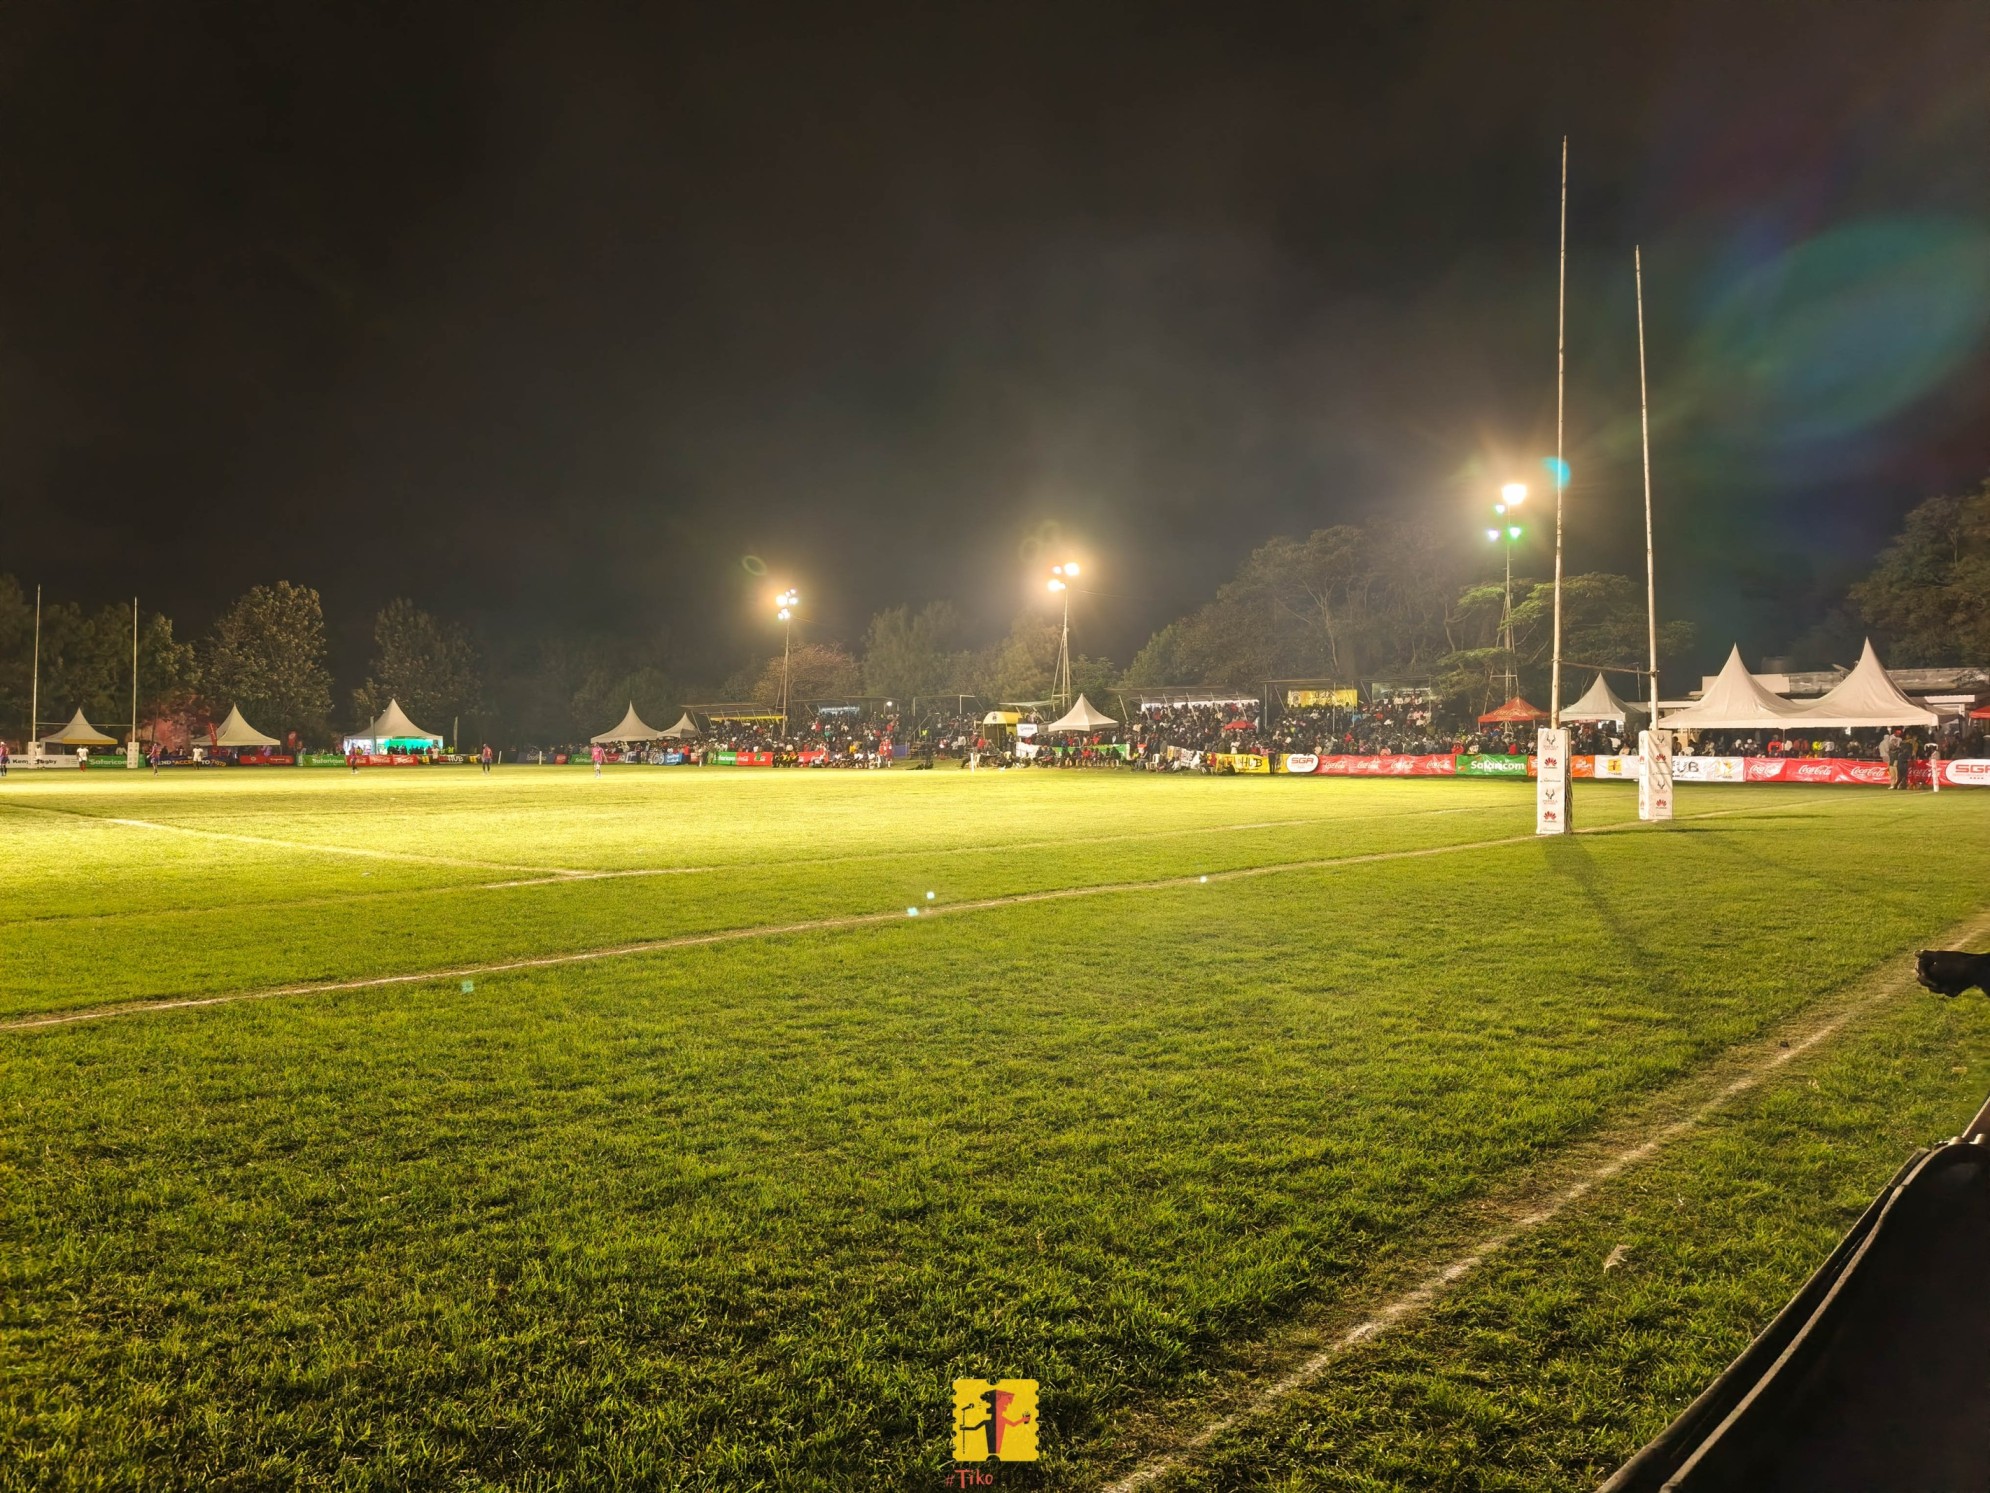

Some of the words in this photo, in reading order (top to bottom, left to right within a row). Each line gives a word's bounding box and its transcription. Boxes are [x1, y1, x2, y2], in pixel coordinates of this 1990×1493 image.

[1470, 760, 1525, 770] Safaricom
[1798, 764, 1834, 776] Coca-Cola
[1850, 766, 1889, 777] Coca-Cola
